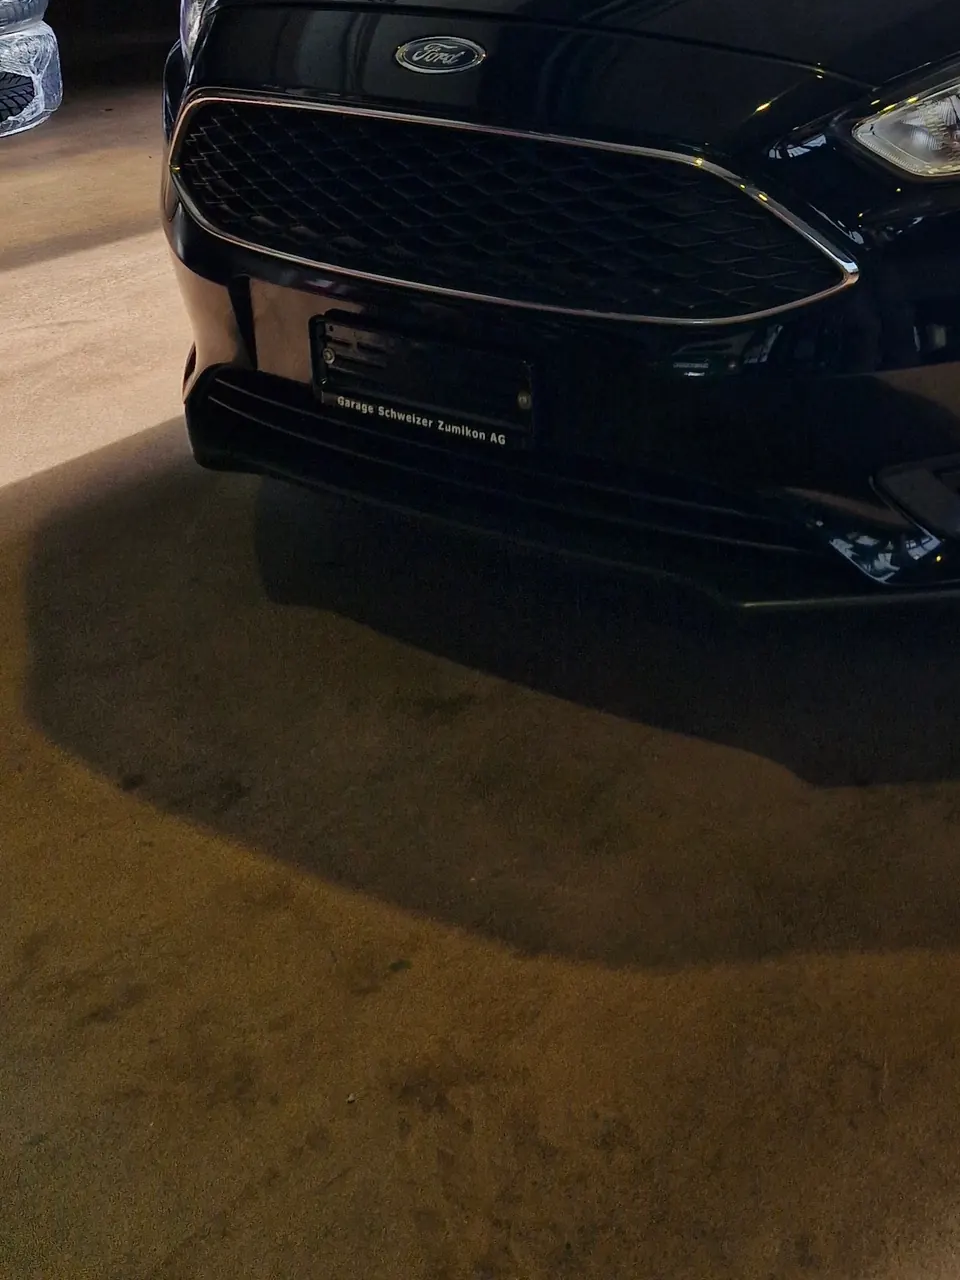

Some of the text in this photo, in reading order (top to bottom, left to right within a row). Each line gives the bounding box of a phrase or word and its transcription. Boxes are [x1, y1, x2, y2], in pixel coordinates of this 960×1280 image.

[411, 42, 466, 66] Ford
[337, 395, 506, 445] Garage Schweizer Zumikon AG
